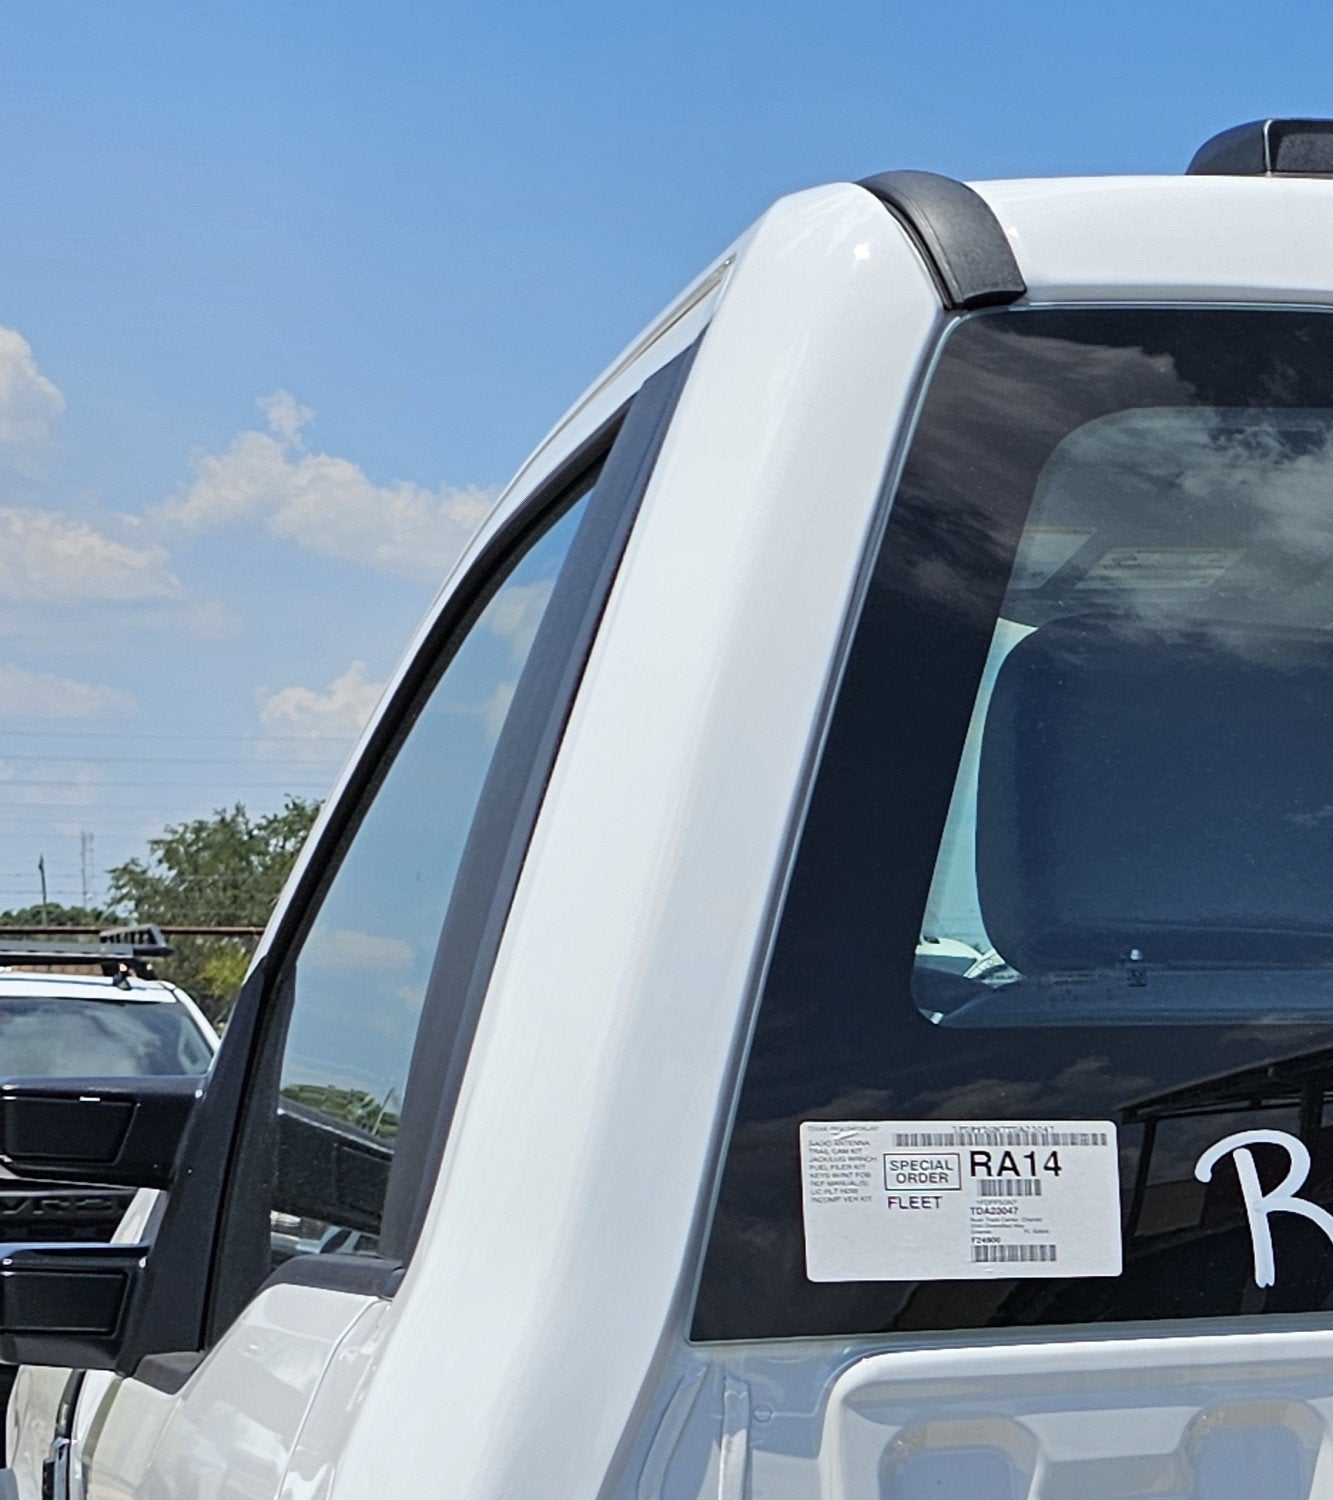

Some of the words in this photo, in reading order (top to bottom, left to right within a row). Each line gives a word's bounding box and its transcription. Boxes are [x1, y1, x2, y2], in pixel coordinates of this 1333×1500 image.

[889, 1159, 953, 1172] SPECIAL
[970, 1150, 1062, 1177] RA14
[896, 1171, 949, 1185] ORDER
[888, 1195, 943, 1209] FLEET
